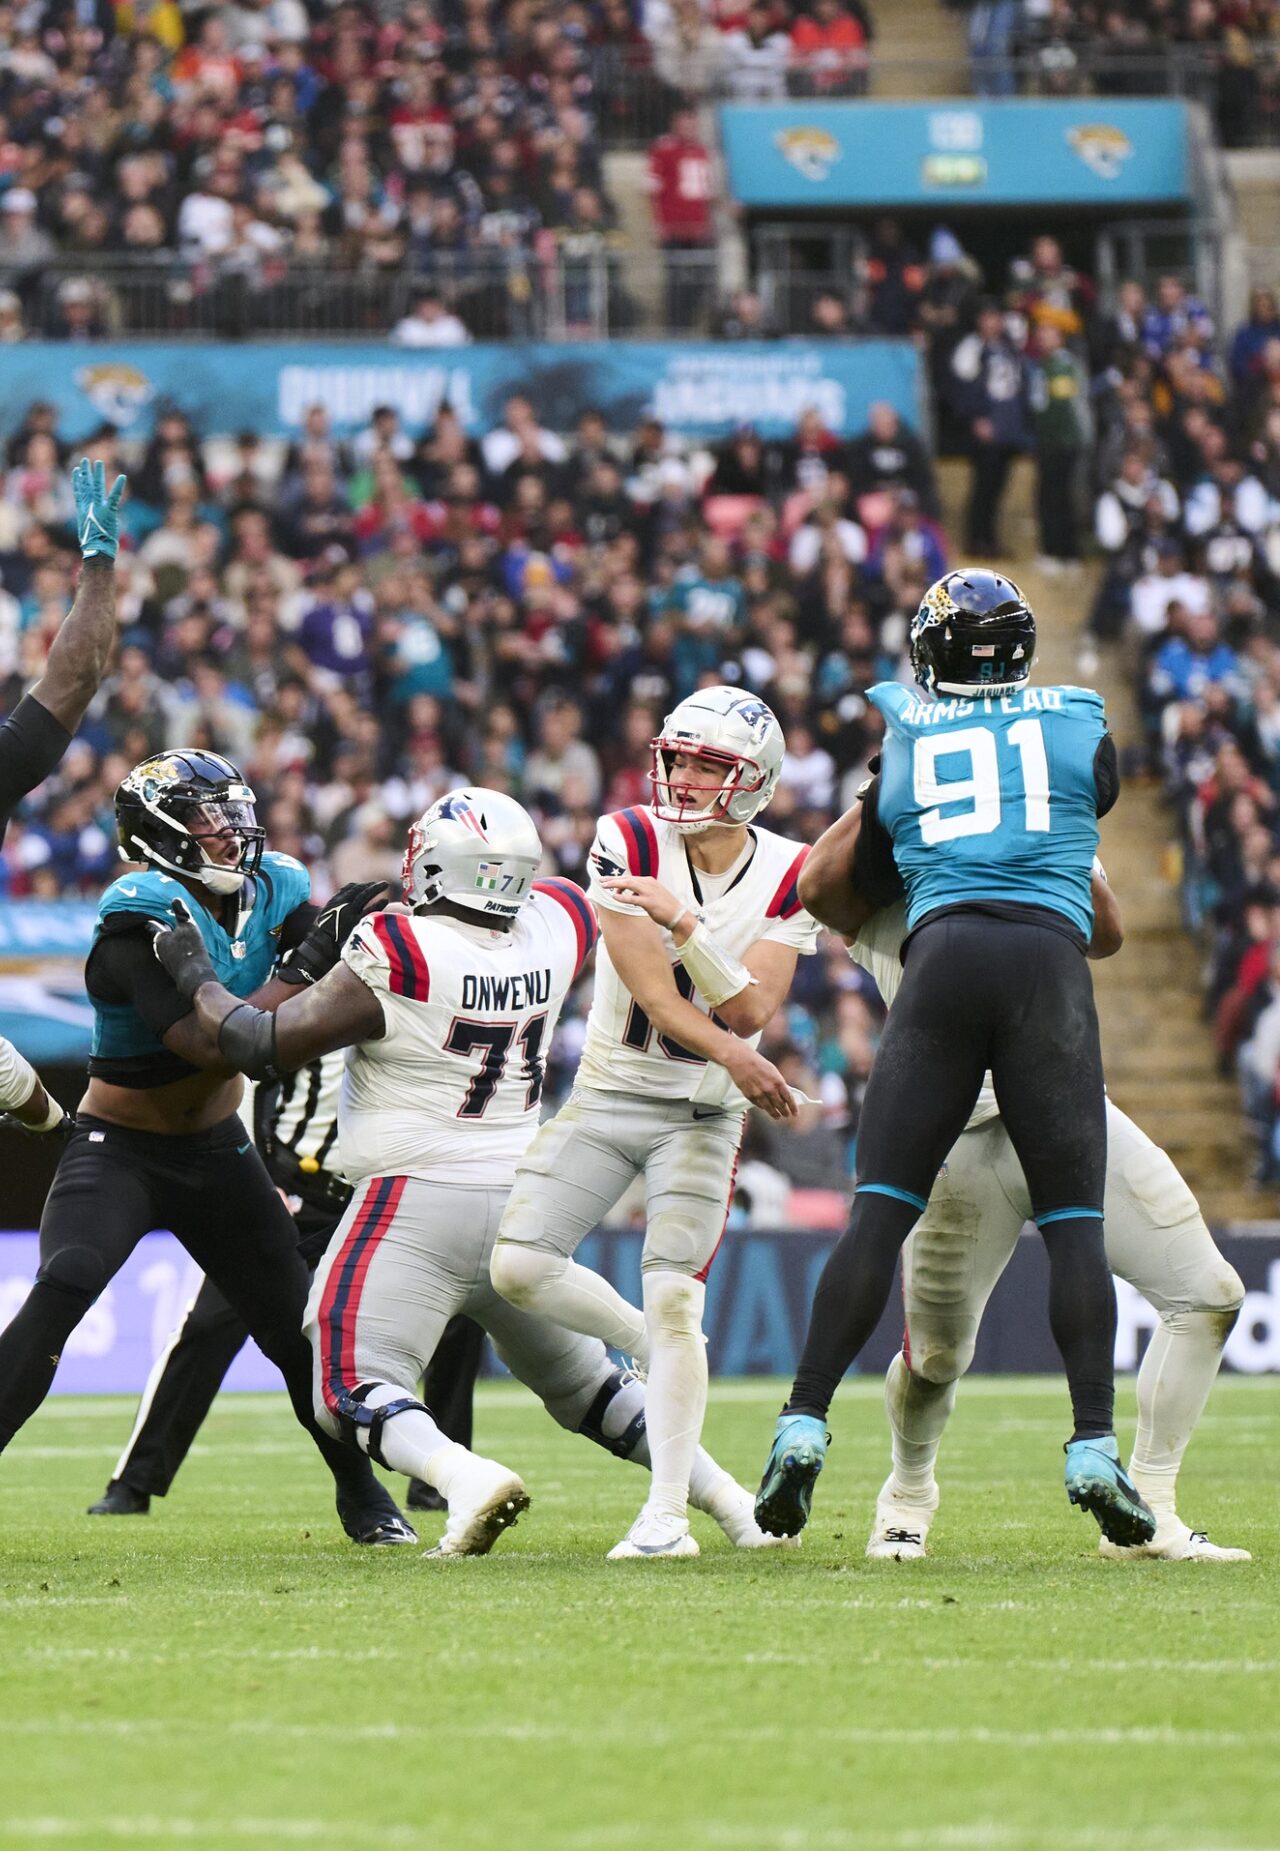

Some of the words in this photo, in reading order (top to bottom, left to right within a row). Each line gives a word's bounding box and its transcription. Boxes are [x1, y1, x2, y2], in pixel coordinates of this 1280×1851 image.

[973, 685, 1017, 698] JAGUARS
[914, 718, 1051, 845] 91
[500, 875, 525, 894] 71
[484, 900, 521, 914] PATRIOTS
[461, 968, 551, 1011] ONWENU
[444, 1011, 548, 1118] 71
